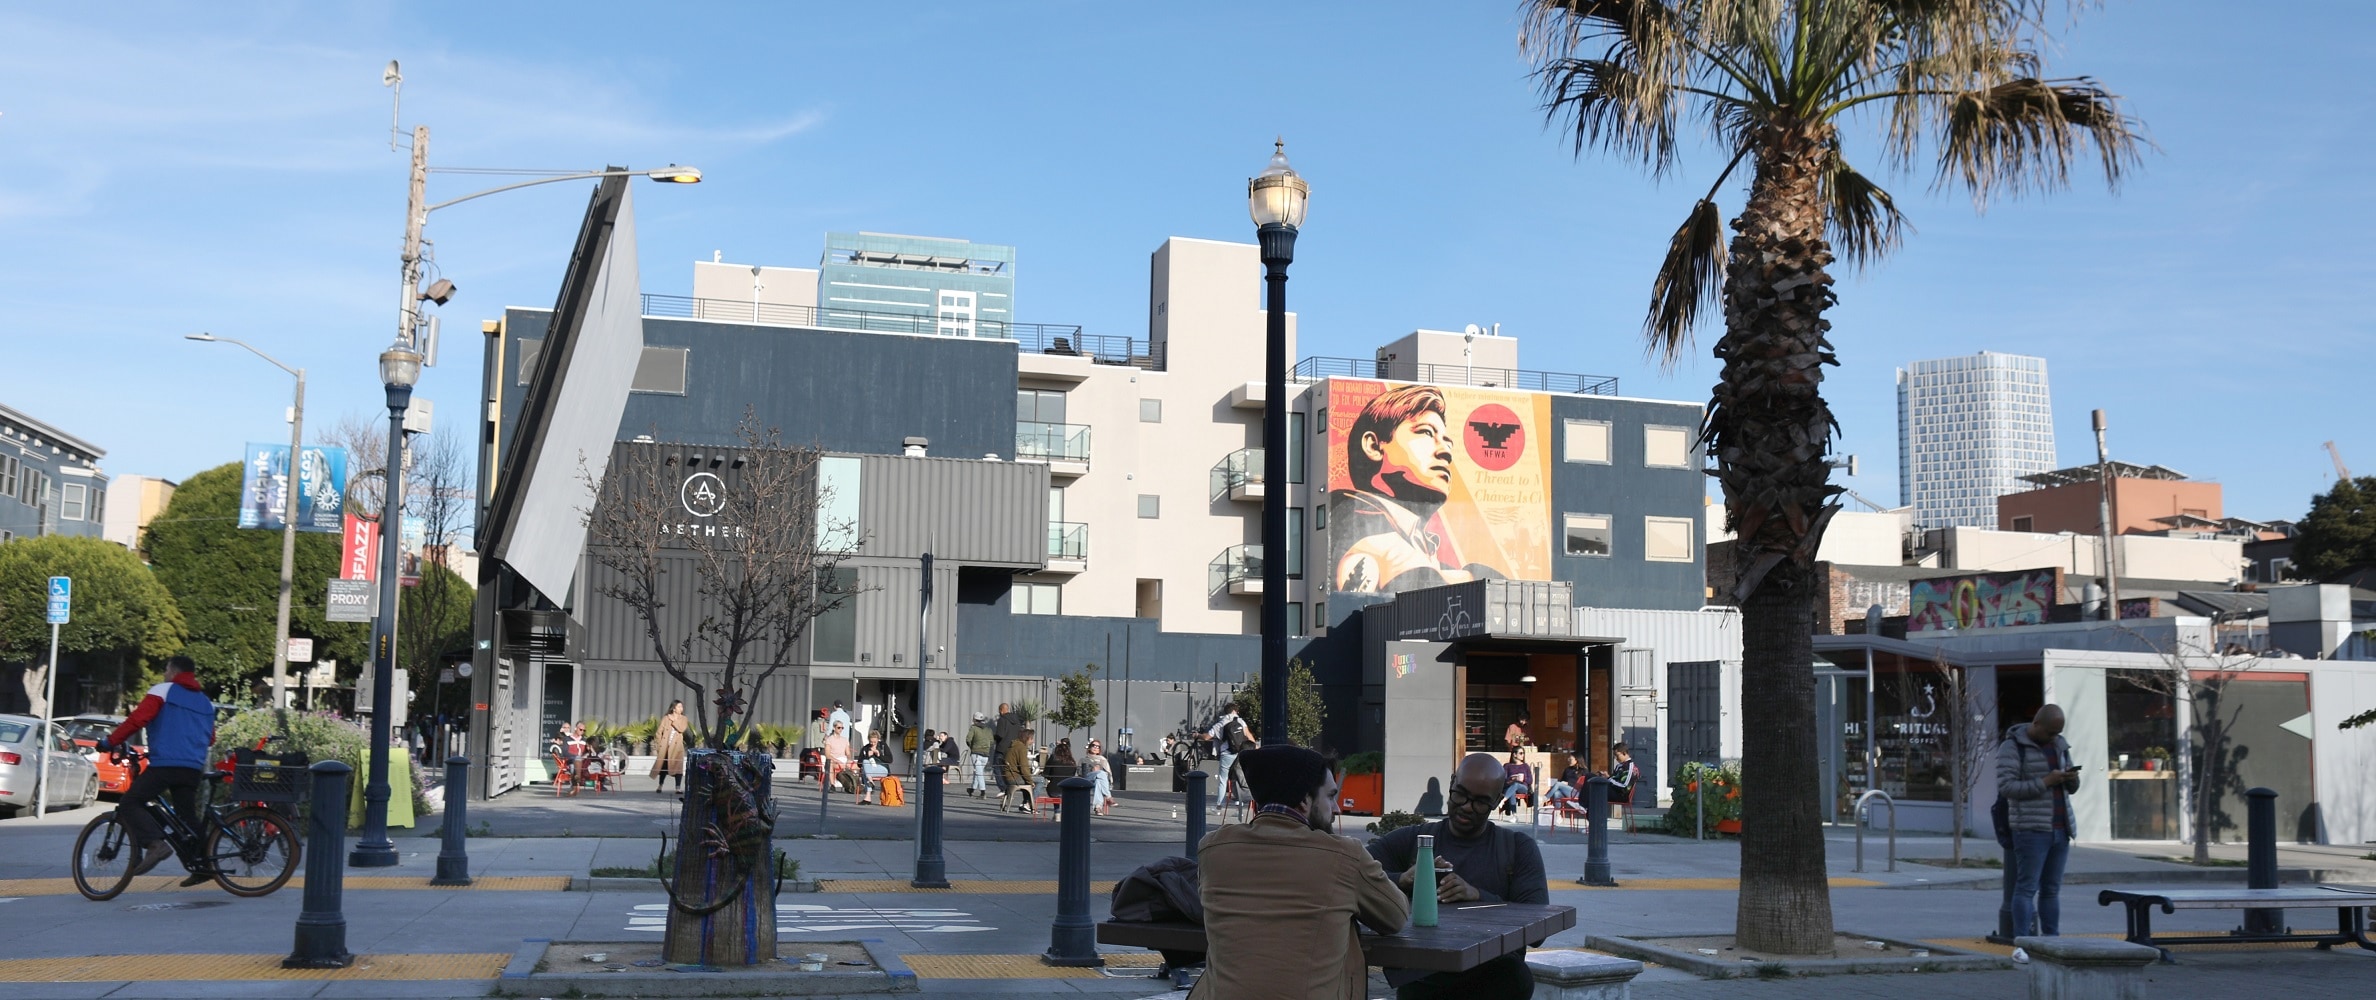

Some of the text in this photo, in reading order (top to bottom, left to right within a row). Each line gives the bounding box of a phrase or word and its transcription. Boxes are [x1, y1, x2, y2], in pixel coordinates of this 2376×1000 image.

[1484, 449, 1506, 459] NFWA
[1475, 470, 1515, 485] Threat
[1519, 476, 1530, 486] to
[352, 521, 370, 580] SFJAZZ
[330, 593, 369, 605] PROXY
[1391, 653, 1415, 668] JUICE
[1396, 663, 1416, 679] SHOP
[1899, 722, 1949, 735] RITUAL
